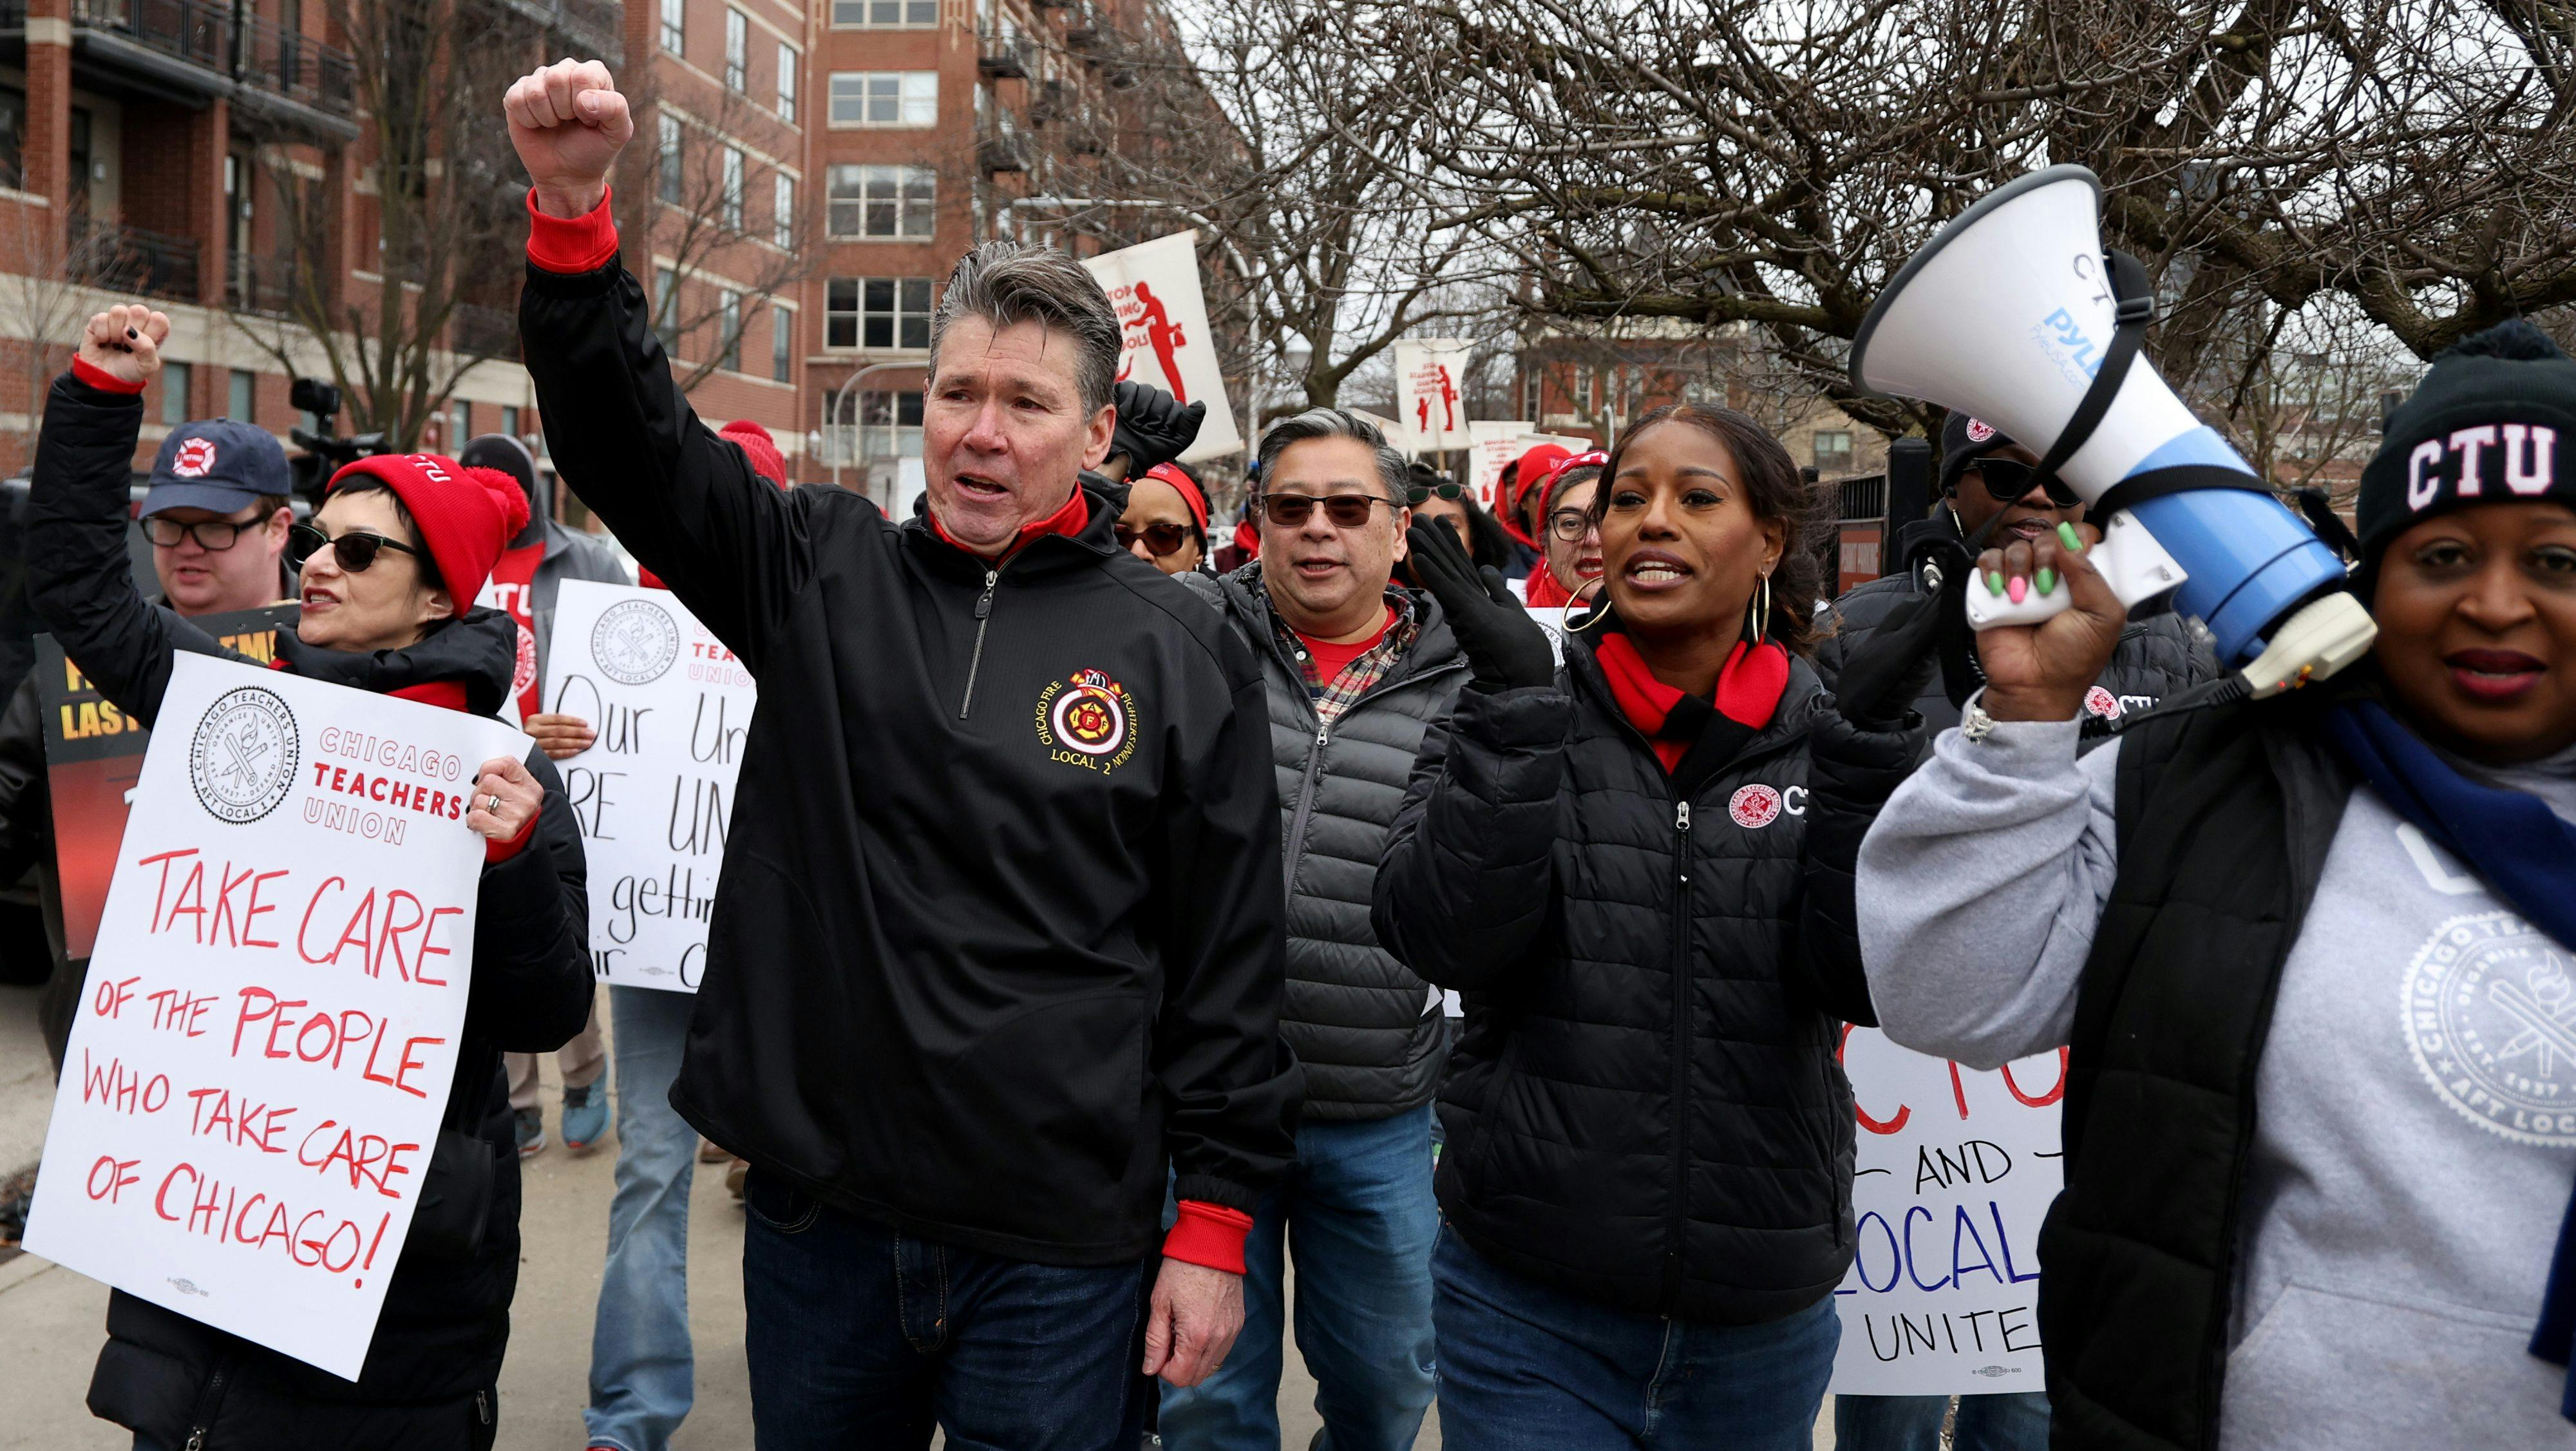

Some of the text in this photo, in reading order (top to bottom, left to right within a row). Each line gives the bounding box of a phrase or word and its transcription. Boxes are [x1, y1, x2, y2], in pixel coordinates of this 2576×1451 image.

[1106, 285, 1132, 302] TOP
[2073, 253, 2117, 310] CT
[1115, 303, 1141, 318] ING
[2407, 423, 2557, 513] CTU
[494, 583, 532, 616] TU
[595, 610, 616, 655] CHICAGO
[620, 603, 670, 625] TEACHERS
[664, 629, 676, 662] UNION
[692, 643, 735, 662] TEA
[620, 673, 651, 681] LOCAL
[688, 663, 751, 687] UNIO
[194, 692, 294, 792] CHICAGO TEACHERS UNION
[213, 712, 278, 747] ORGANIZE UNITE
[554, 674, 654, 760] Our
[691, 692, 748, 765] Un
[1035, 680, 1138, 768] CHICAGO FIRE FIGHTERS UNION
[249, 763, 276, 797] DEFEND
[319, 726, 461, 782] CHICAGO
[1050, 749, 1111, 775] LOCAL 2
[200, 786, 267, 819] AFT LOCAL 1
[314, 761, 462, 821] TEACHERS
[566, 768, 628, 840] RE
[668, 775, 726, 856] UN
[1783, 785, 1809, 816] C
[303, 797, 407, 846] UNION
[138, 848, 464, 987] TAKE CARE
[2416, 926, 2473, 1054] CHICAGO
[95, 976, 446, 1099] OF THE PEOPLE
[84, 1047, 419, 1199] WHO TAKE CARE
[2450, 1078, 2576, 1134] AFT LOC
[1915, 1140, 2012, 1195] AND
[87, 1155, 390, 1289] OF CHICAGO!
[1864, 1307, 2043, 1361] UNITE
